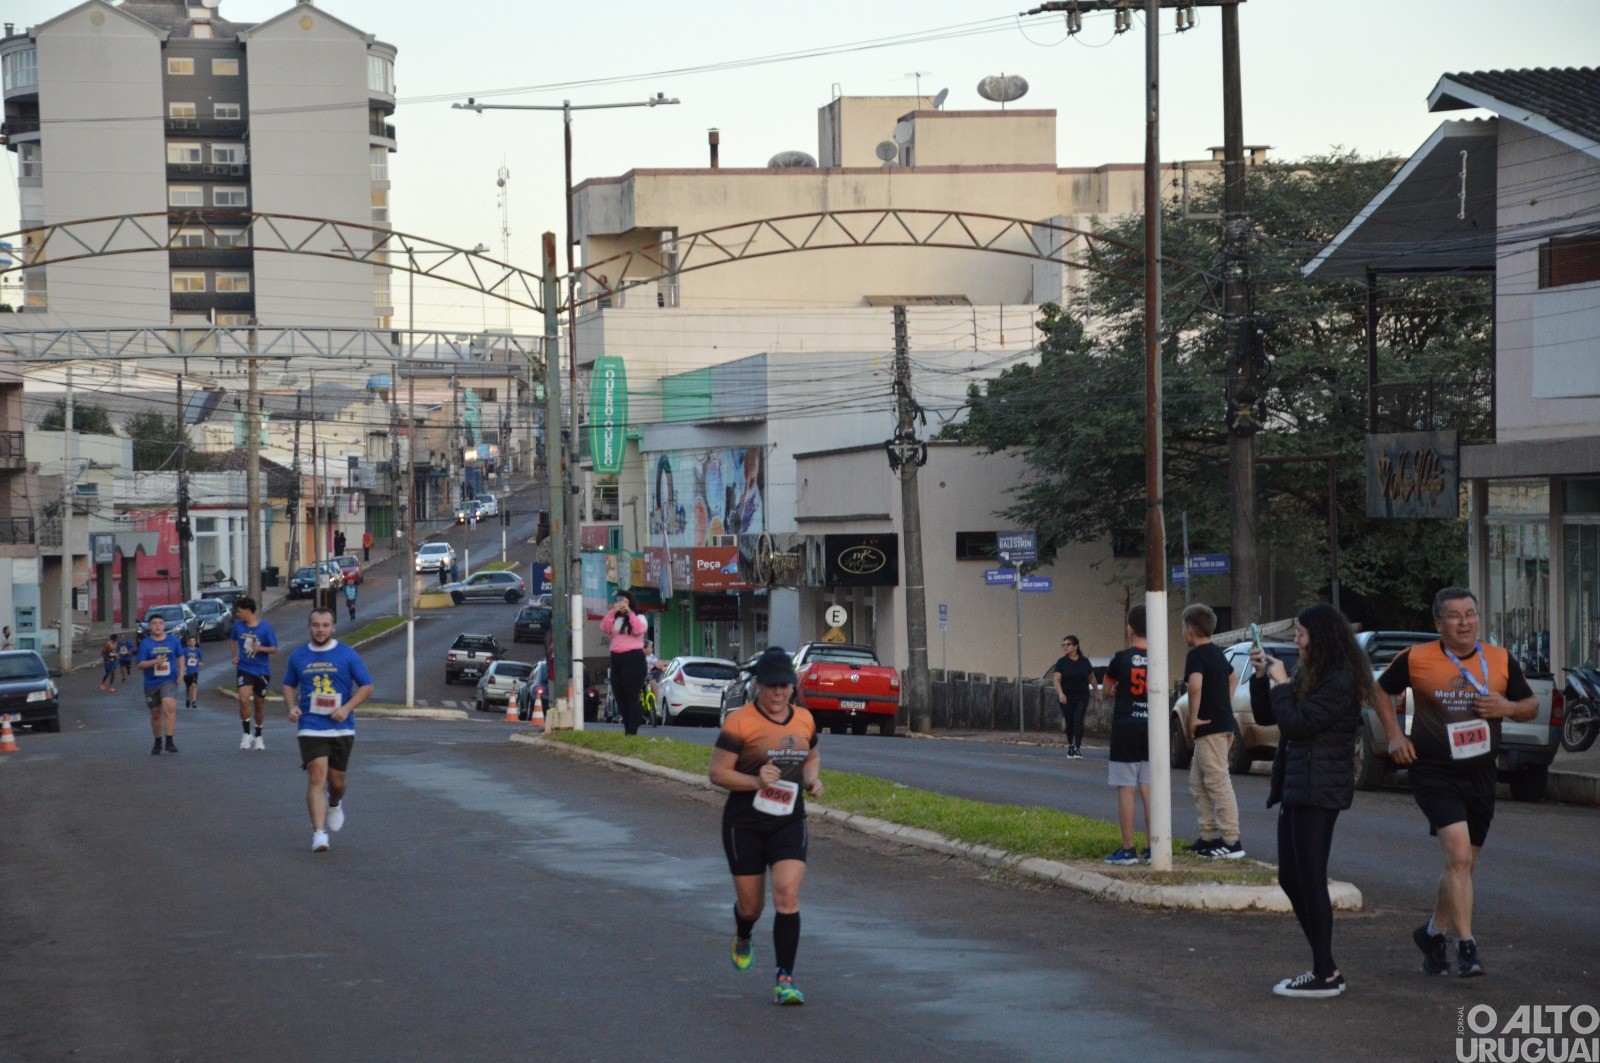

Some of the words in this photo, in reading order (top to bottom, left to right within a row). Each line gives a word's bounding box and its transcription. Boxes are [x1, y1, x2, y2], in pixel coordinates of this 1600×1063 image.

[999, 540, 1032, 549] BALESTRIN
[697, 559, 721, 571] Peça
[832, 610, 840, 623] E
[1130, 668, 1148, 696] 5
[1434, 690, 1456, 698] Med
[1459, 729, 1483, 744] 121
